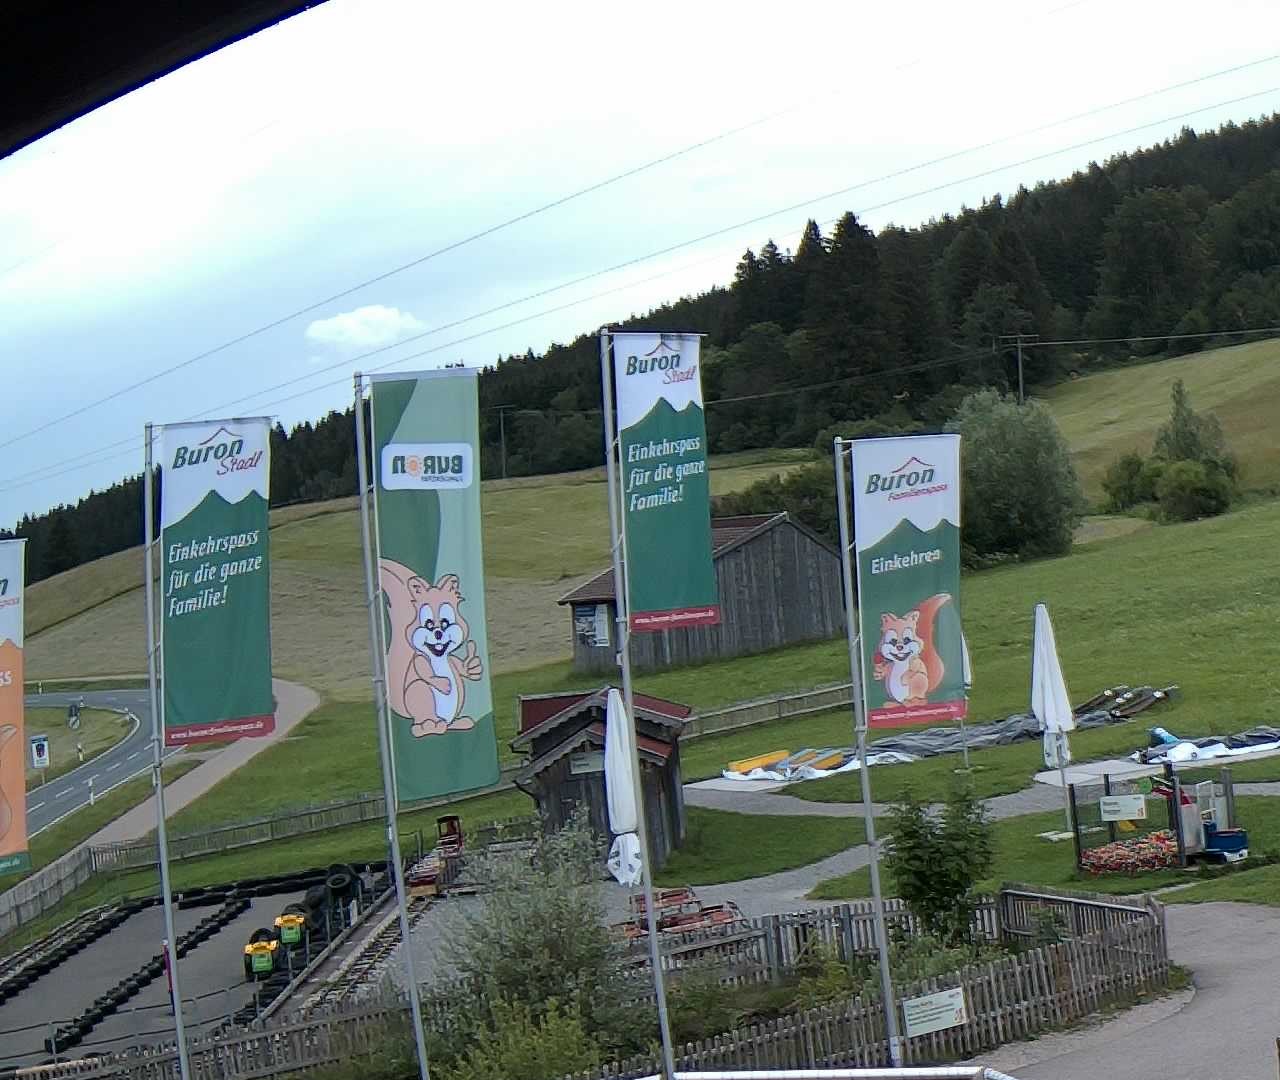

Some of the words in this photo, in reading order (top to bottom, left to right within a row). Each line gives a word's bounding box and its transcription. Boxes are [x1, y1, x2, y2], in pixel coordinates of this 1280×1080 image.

[626, 355, 681, 376] Buron
[172, 439, 244, 470] Buron
[626, 467, 650, 493] für
[654, 462, 673, 482] die
[865, 468, 935, 495] Buron
[629, 484, 684, 512] Familie!
[168, 531, 260, 564] Einkehrspass
[871, 548, 941, 575] Einkehren
[166, 570, 189, 597] für
[194, 562, 216, 585] die
[220, 556, 263, 583] ganze
[168, 585, 229, 619] Familie!
